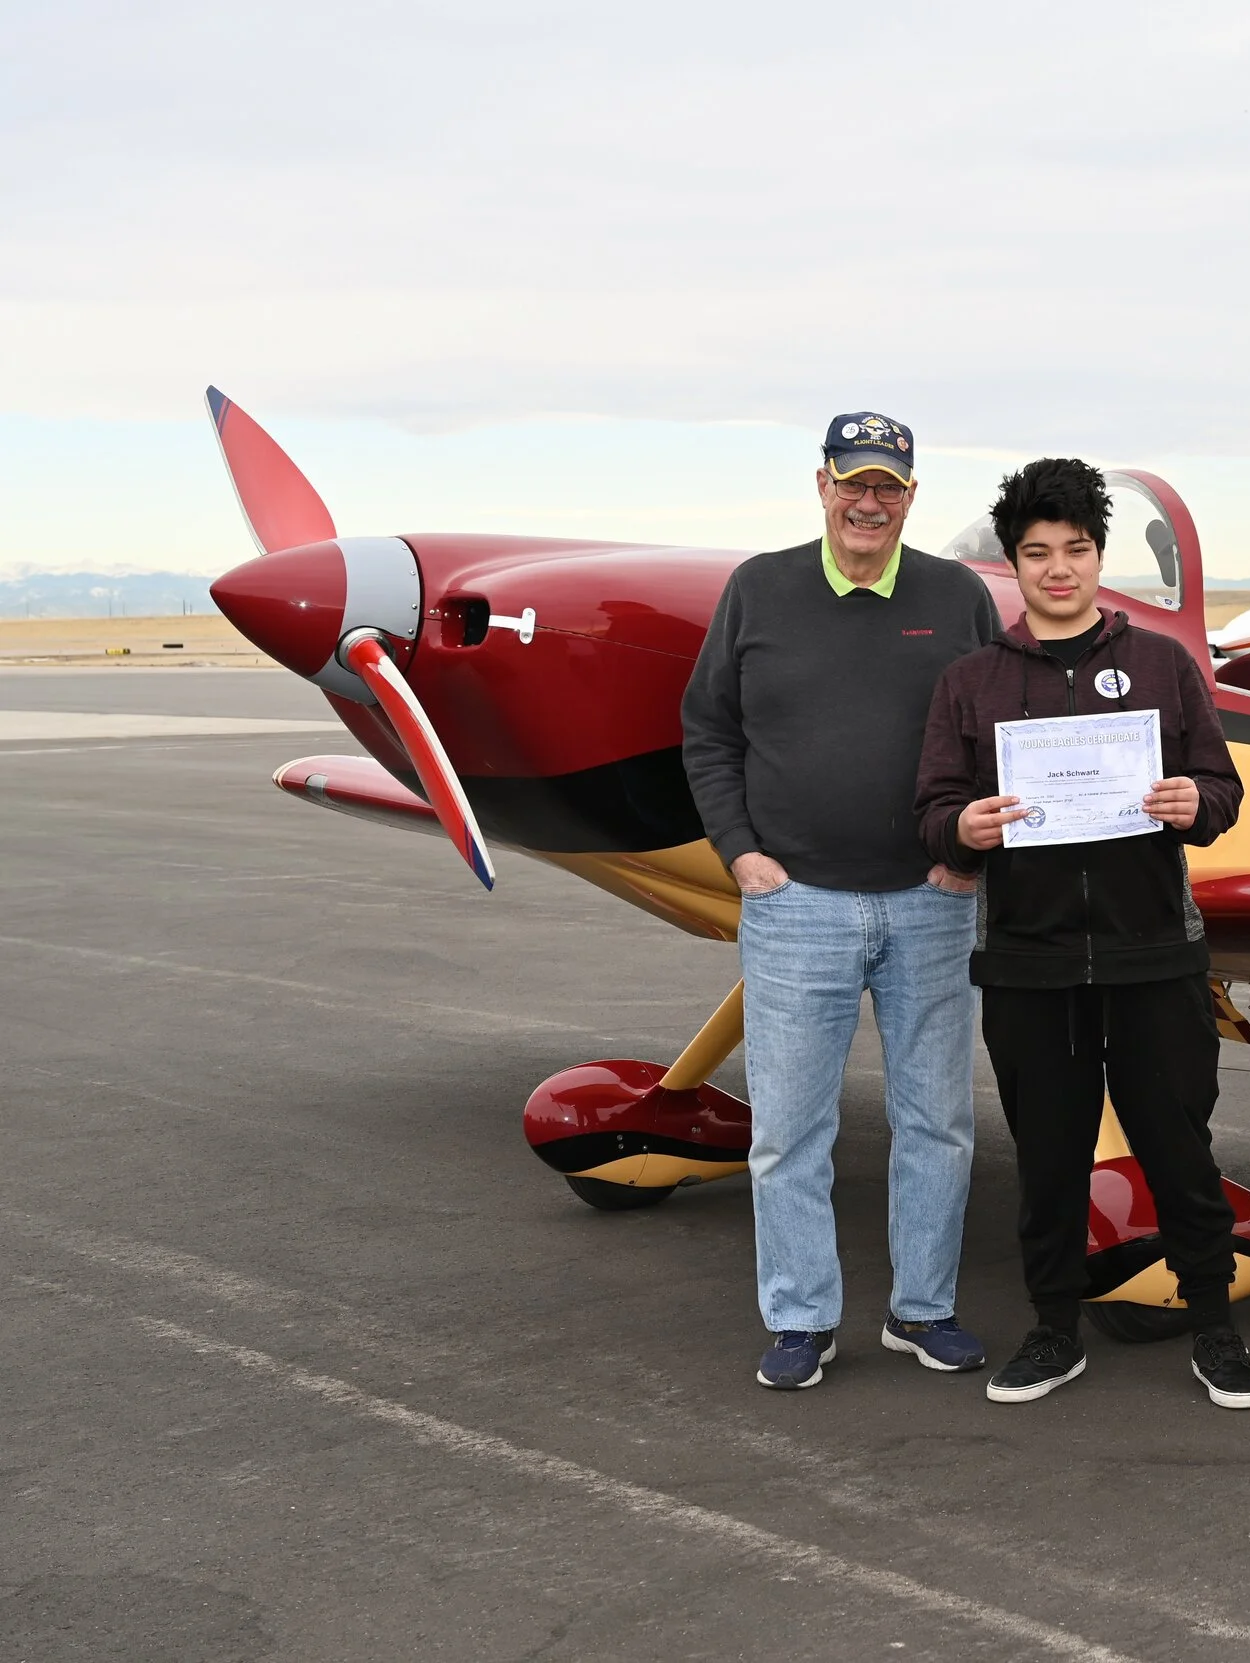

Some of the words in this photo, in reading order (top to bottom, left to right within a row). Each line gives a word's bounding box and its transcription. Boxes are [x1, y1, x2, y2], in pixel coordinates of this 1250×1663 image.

[873, 440, 895, 449] LEADER
[1018, 738, 1052, 750] YOUNG
[1052, 735, 1087, 748] EAGLES
[1087, 731, 1140, 745] CERTIFICATE
[1066, 769, 1100, 778] Schwartz
[1118, 808, 1139, 817] EAA
